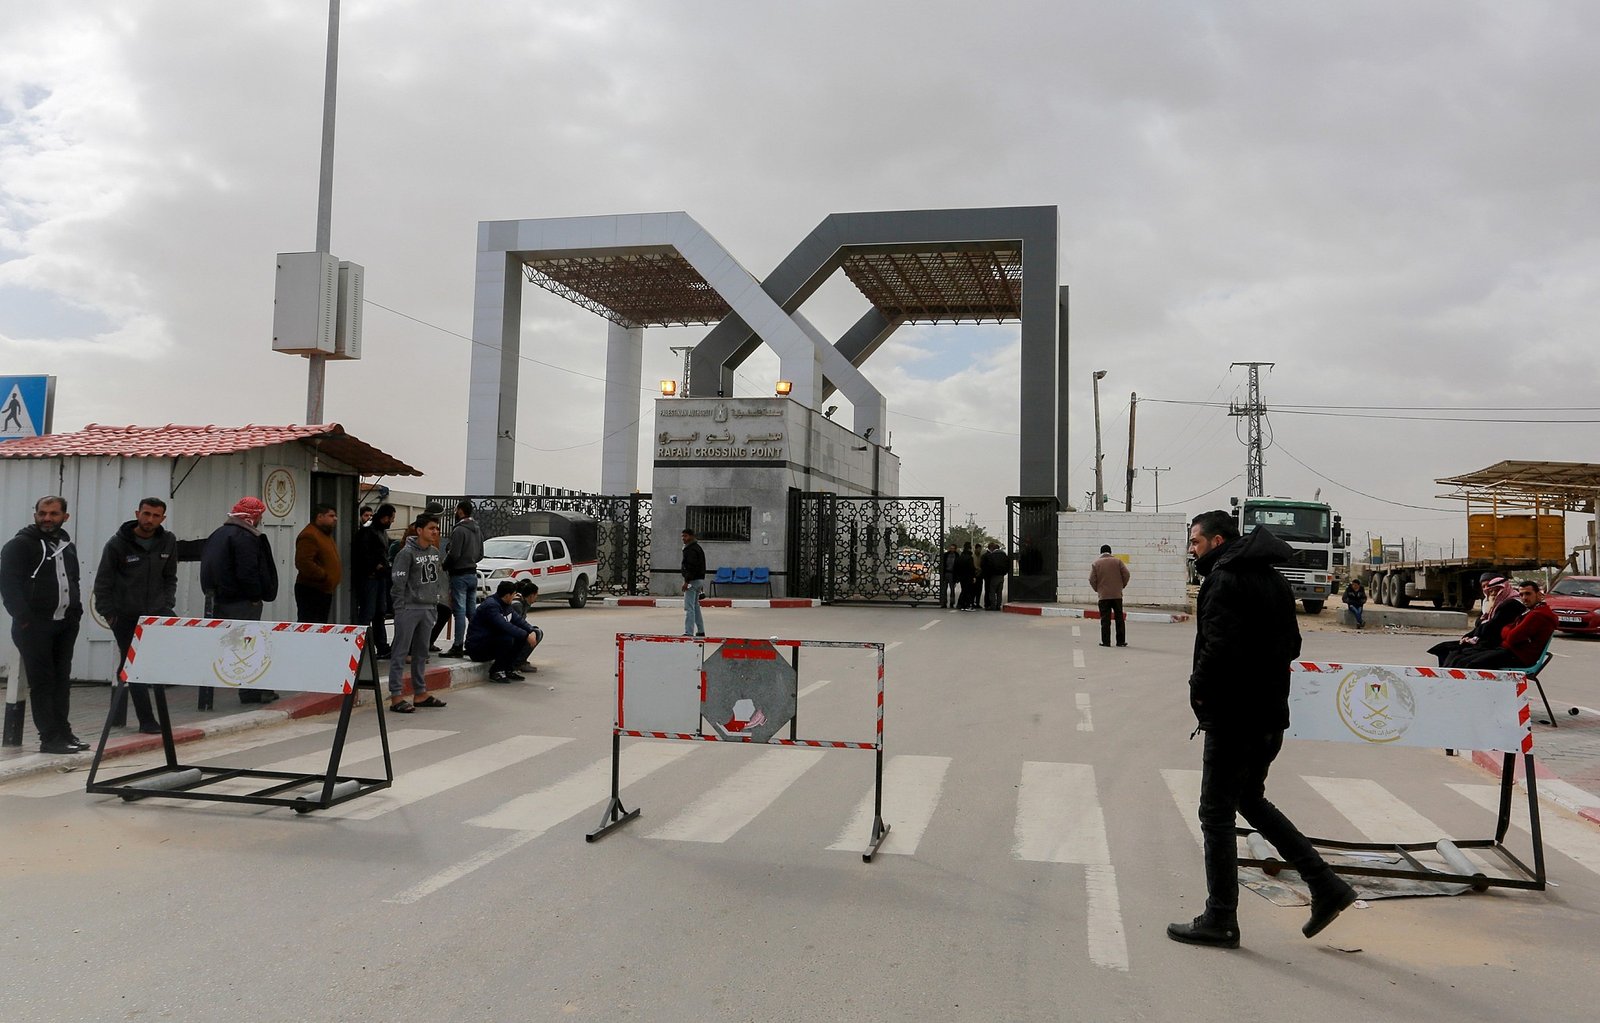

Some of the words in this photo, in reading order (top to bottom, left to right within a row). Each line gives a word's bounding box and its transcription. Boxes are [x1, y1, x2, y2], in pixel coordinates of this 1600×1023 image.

[706, 428, 735, 444] رفح
[744, 432, 783, 445] معبر
[658, 447, 691, 457] RAFAH
[694, 447, 746, 458] CROSSING
[750, 447, 782, 458] POINT
[420, 562, 438, 584] 13
